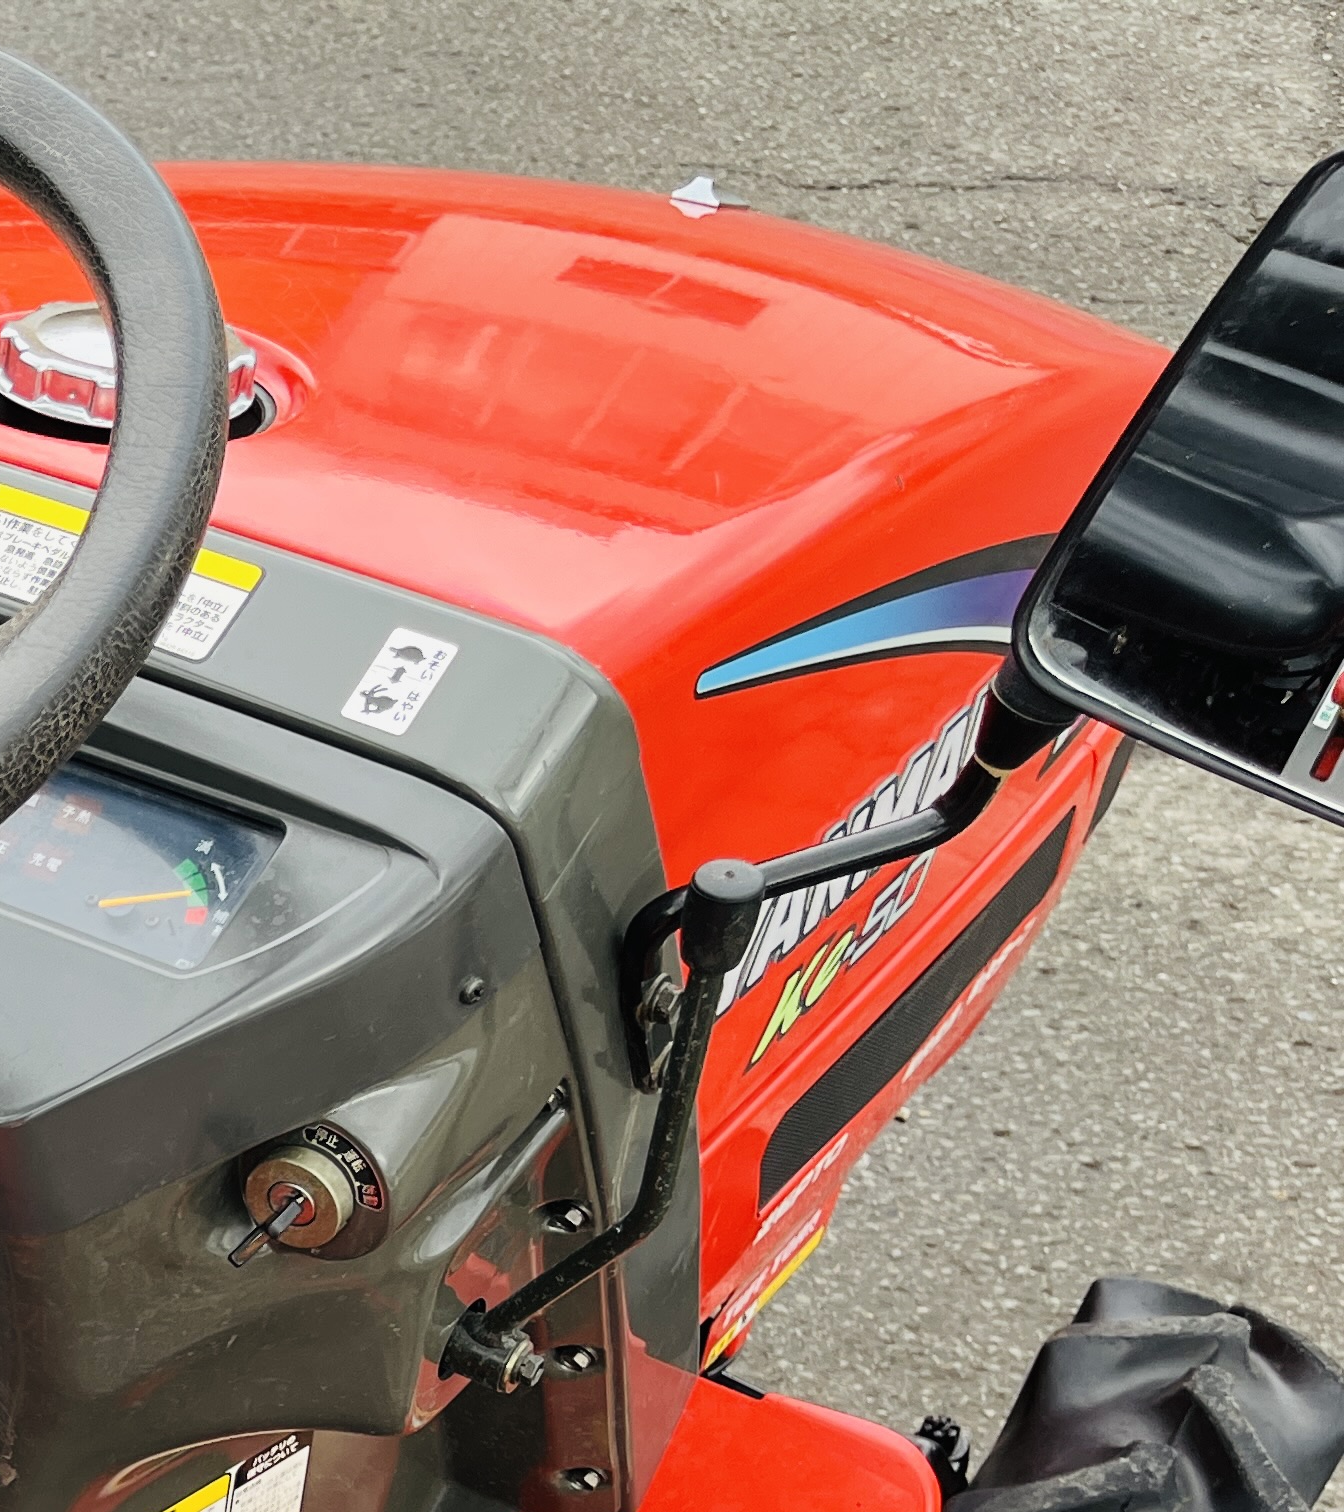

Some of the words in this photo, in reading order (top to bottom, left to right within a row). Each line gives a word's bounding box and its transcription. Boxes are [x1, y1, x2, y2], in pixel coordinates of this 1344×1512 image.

[420, 650, 448, 681] おそい
[393, 691, 420, 722] はやい
[62, 804, 91, 824] 予熱
[28, 852, 62, 872] 充電
[714, 684, 1082, 1015] YANMA
[314, 1126, 341, 1149] 停止
